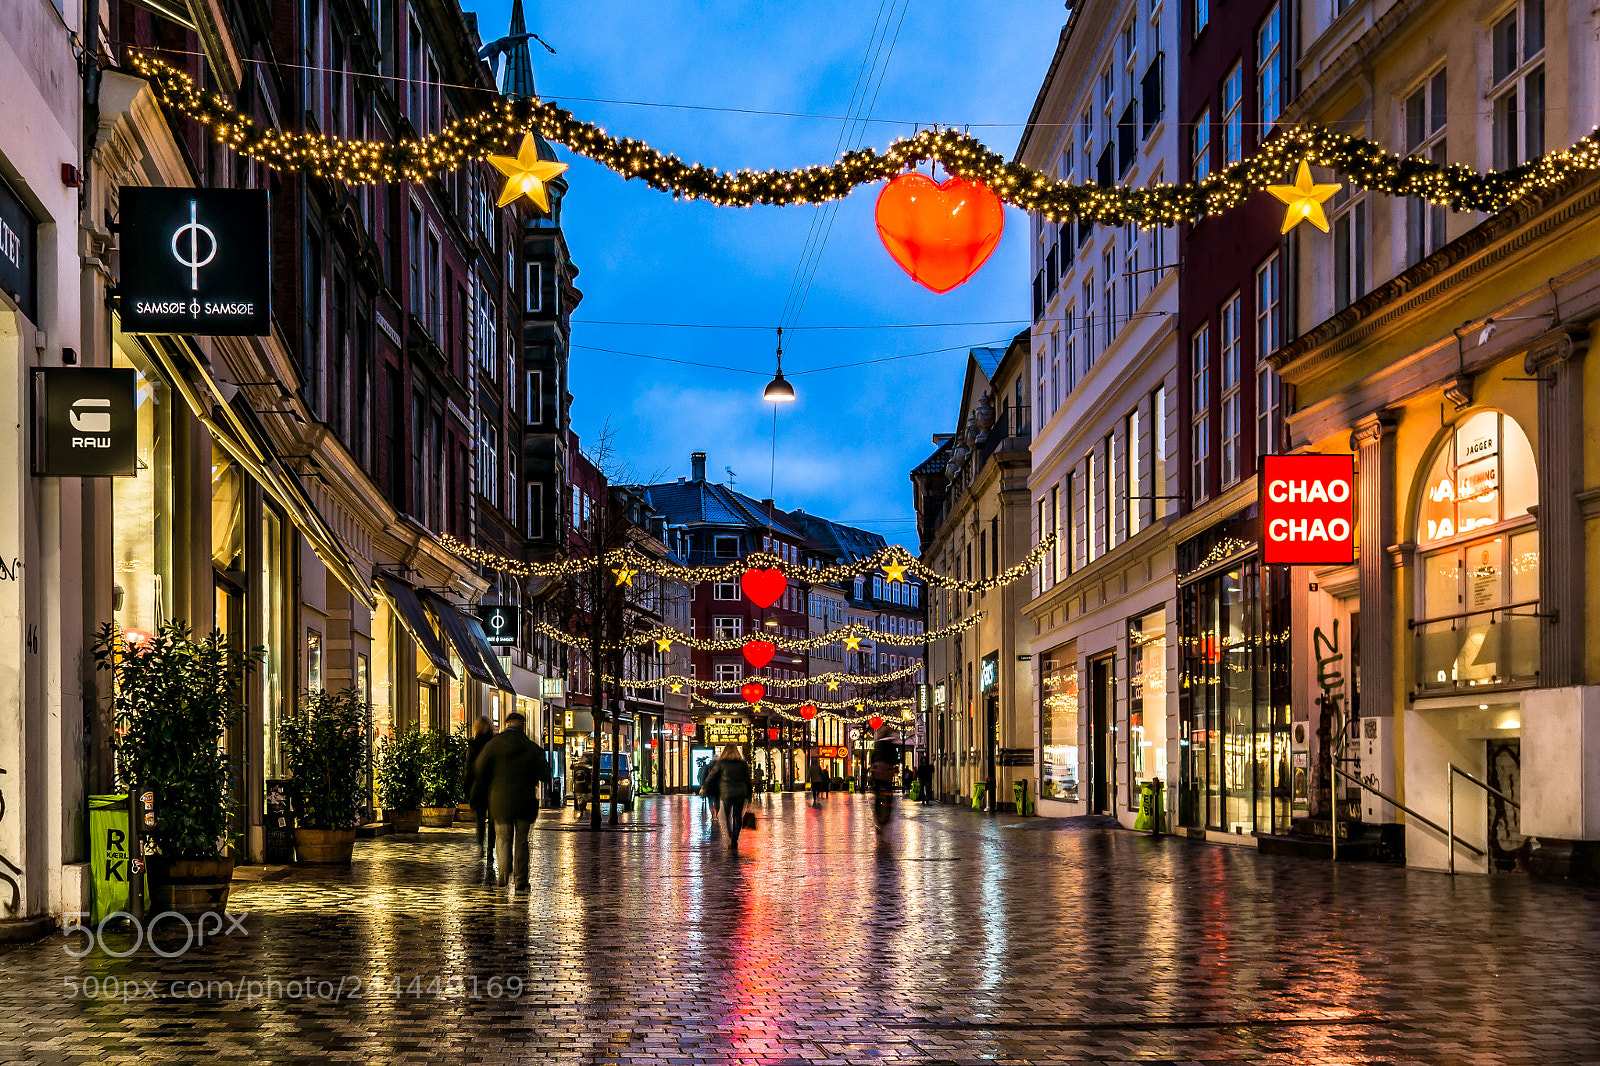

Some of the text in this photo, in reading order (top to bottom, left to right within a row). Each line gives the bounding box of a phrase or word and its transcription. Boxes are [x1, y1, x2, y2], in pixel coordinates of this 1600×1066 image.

[136, 301, 254, 315] SAMSØE SAMSØE
[71, 436, 111, 449] RAW
[1465, 438, 1494, 456] JAGGER
[1268, 479, 1350, 504] CHAO
[1268, 517, 1350, 543] CHAO
[27, 623, 38, 655] 46
